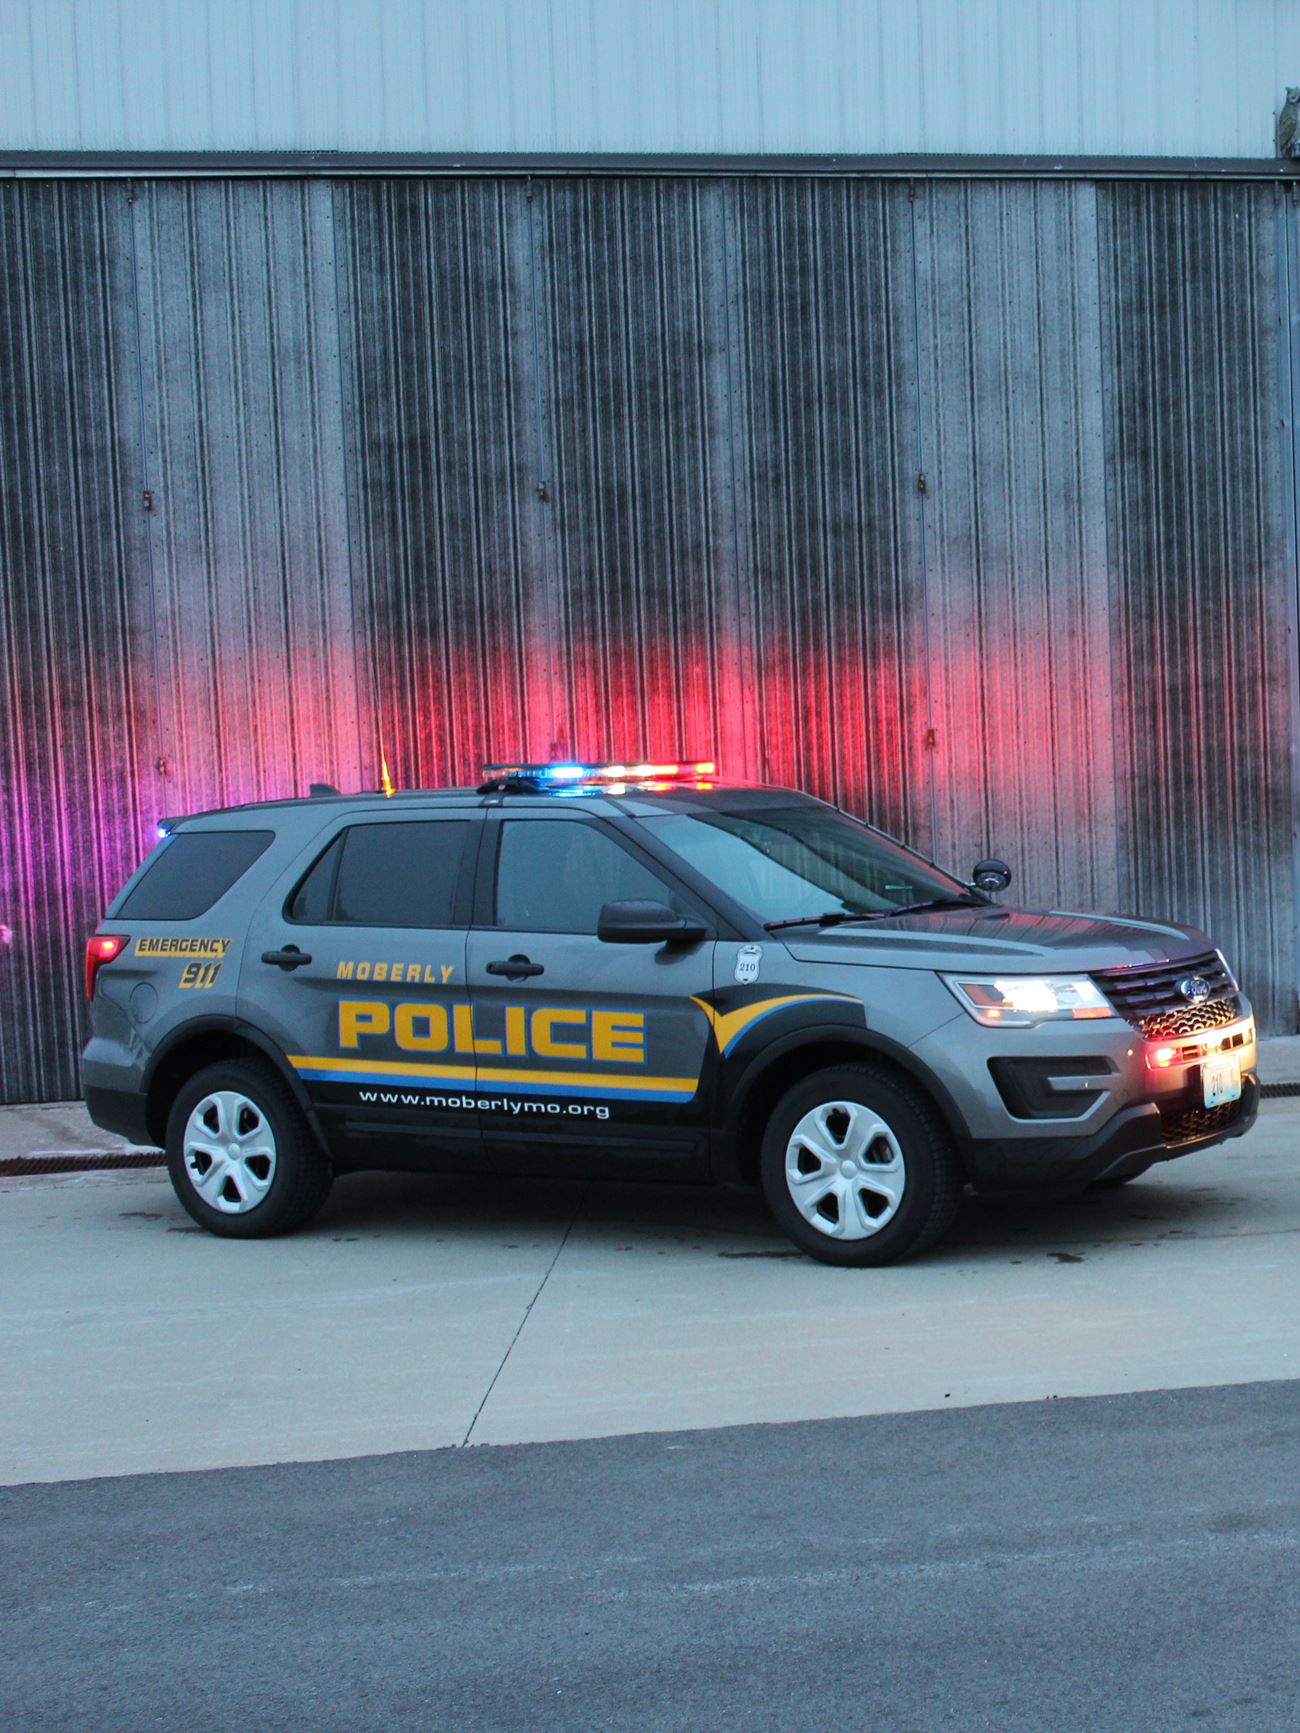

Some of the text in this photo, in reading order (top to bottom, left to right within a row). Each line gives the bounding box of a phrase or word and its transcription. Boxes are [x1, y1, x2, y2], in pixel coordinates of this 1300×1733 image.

[136, 937, 231, 955] EMERGENCY
[180, 961, 222, 987] 911
[337, 961, 454, 983] MOBERLY
[740, 963, 756, 972] 210
[337, 999, 647, 1064] POLICE
[359, 1090, 610, 1119] www.moberlymo.org
